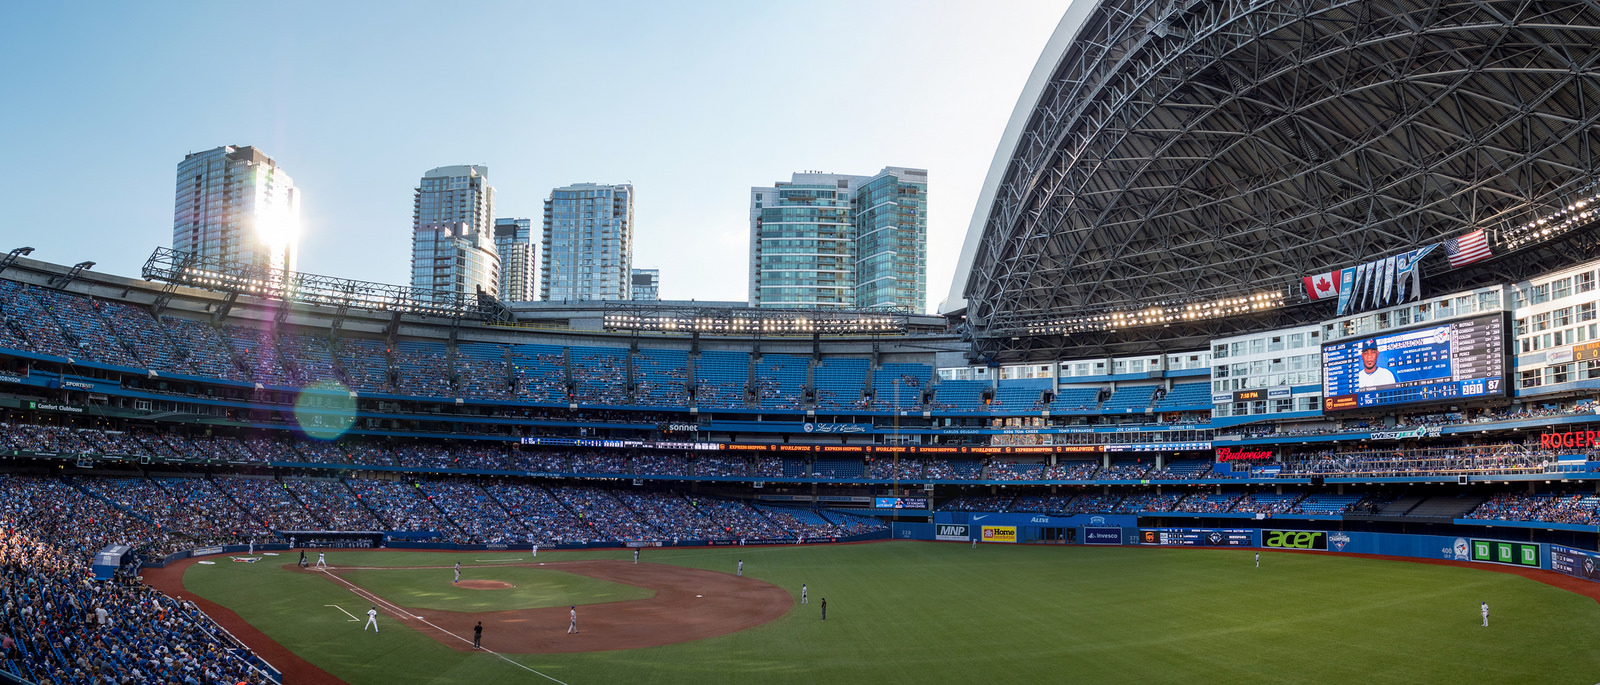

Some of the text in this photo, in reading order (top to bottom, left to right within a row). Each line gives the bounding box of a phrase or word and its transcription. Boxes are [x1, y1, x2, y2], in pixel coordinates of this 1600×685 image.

[1577, 352, 1581, 360] 0
[1593, 349, 1598, 358] 0
[1488, 380, 1499, 389] 87
[816, 423, 834, 432] Level
[840, 424, 865, 432] Excellence
[1216, 448, 1272, 461] Budweiser
[941, 526, 965, 535] MNP
[1267, 531, 1322, 549] acer
[1477, 545, 1534, 560] TD TD TD
